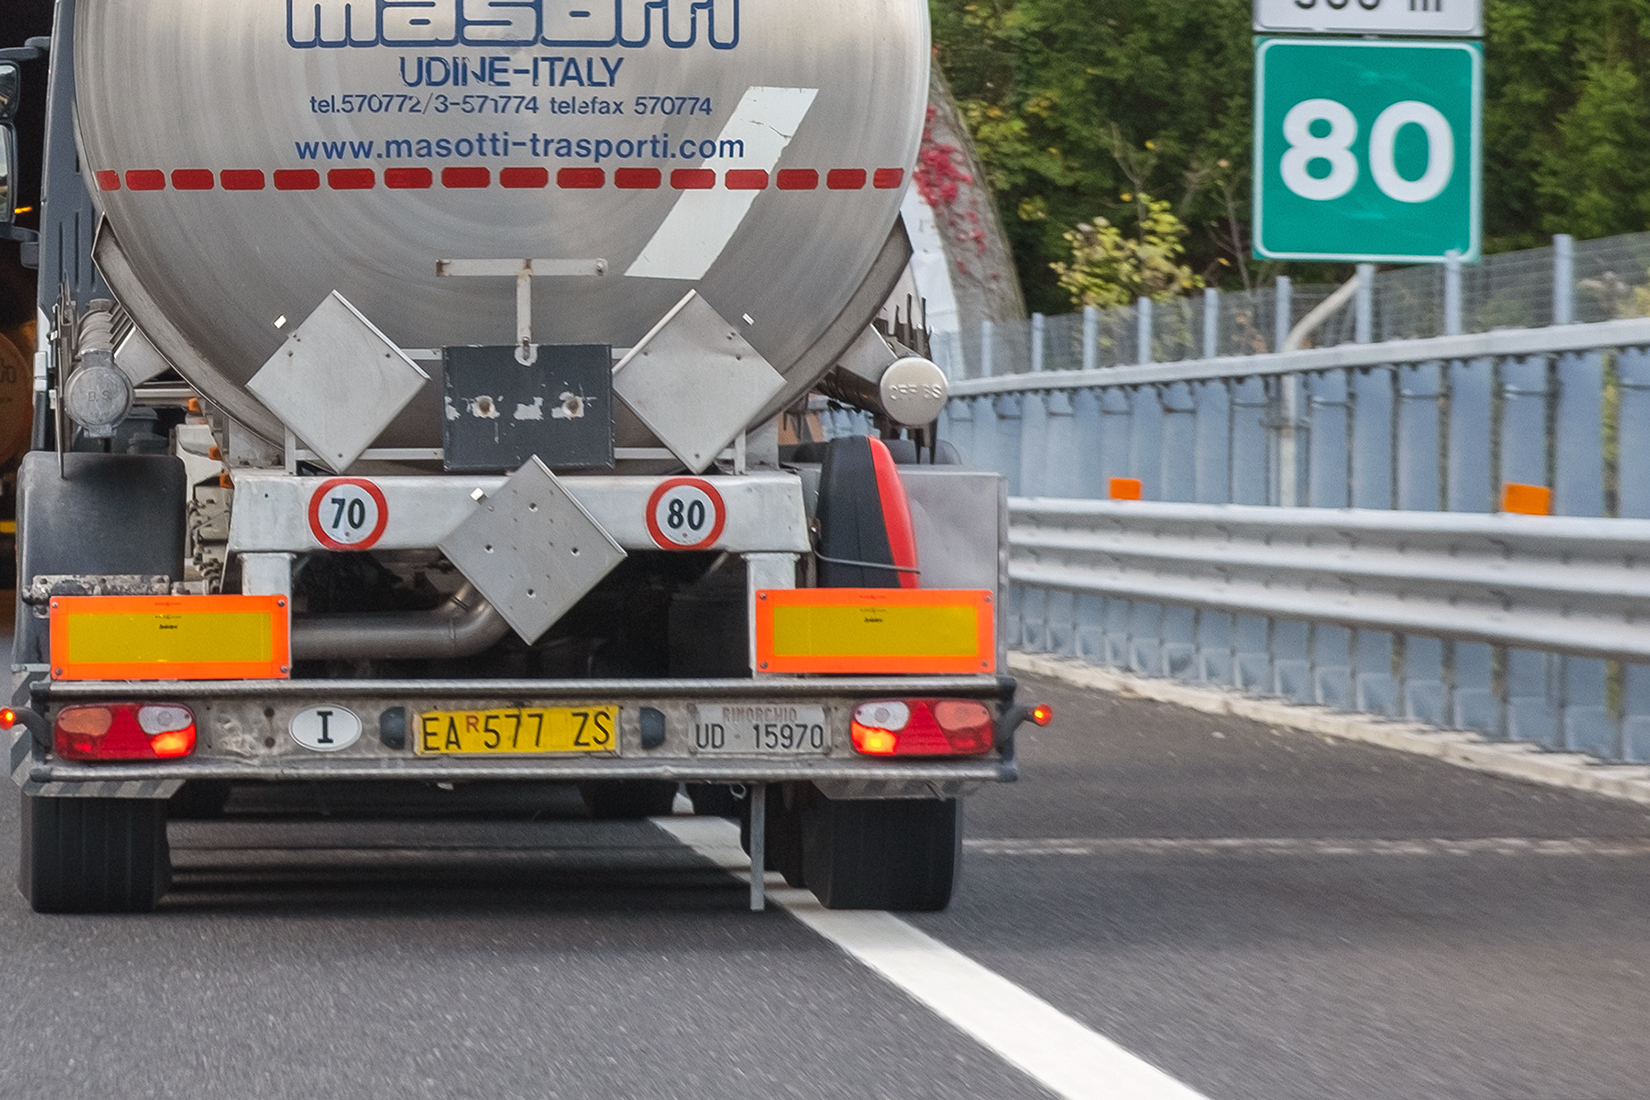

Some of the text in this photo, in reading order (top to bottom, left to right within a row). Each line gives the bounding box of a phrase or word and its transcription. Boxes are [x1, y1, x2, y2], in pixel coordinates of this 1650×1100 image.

[399, 56, 625, 88] UDINE-ITALY
[550, 93, 624, 116] telefax
[633, 97, 712, 115] 570774
[295, 132, 745, 163] www.masotti-trasporti.com
[1280, 98, 1454, 203] 80
[330, 497, 366, 530] 70
[667, 498, 706, 532] 80
[317, 711, 334, 744] I
[696, 723, 823, 749] UD 15970
